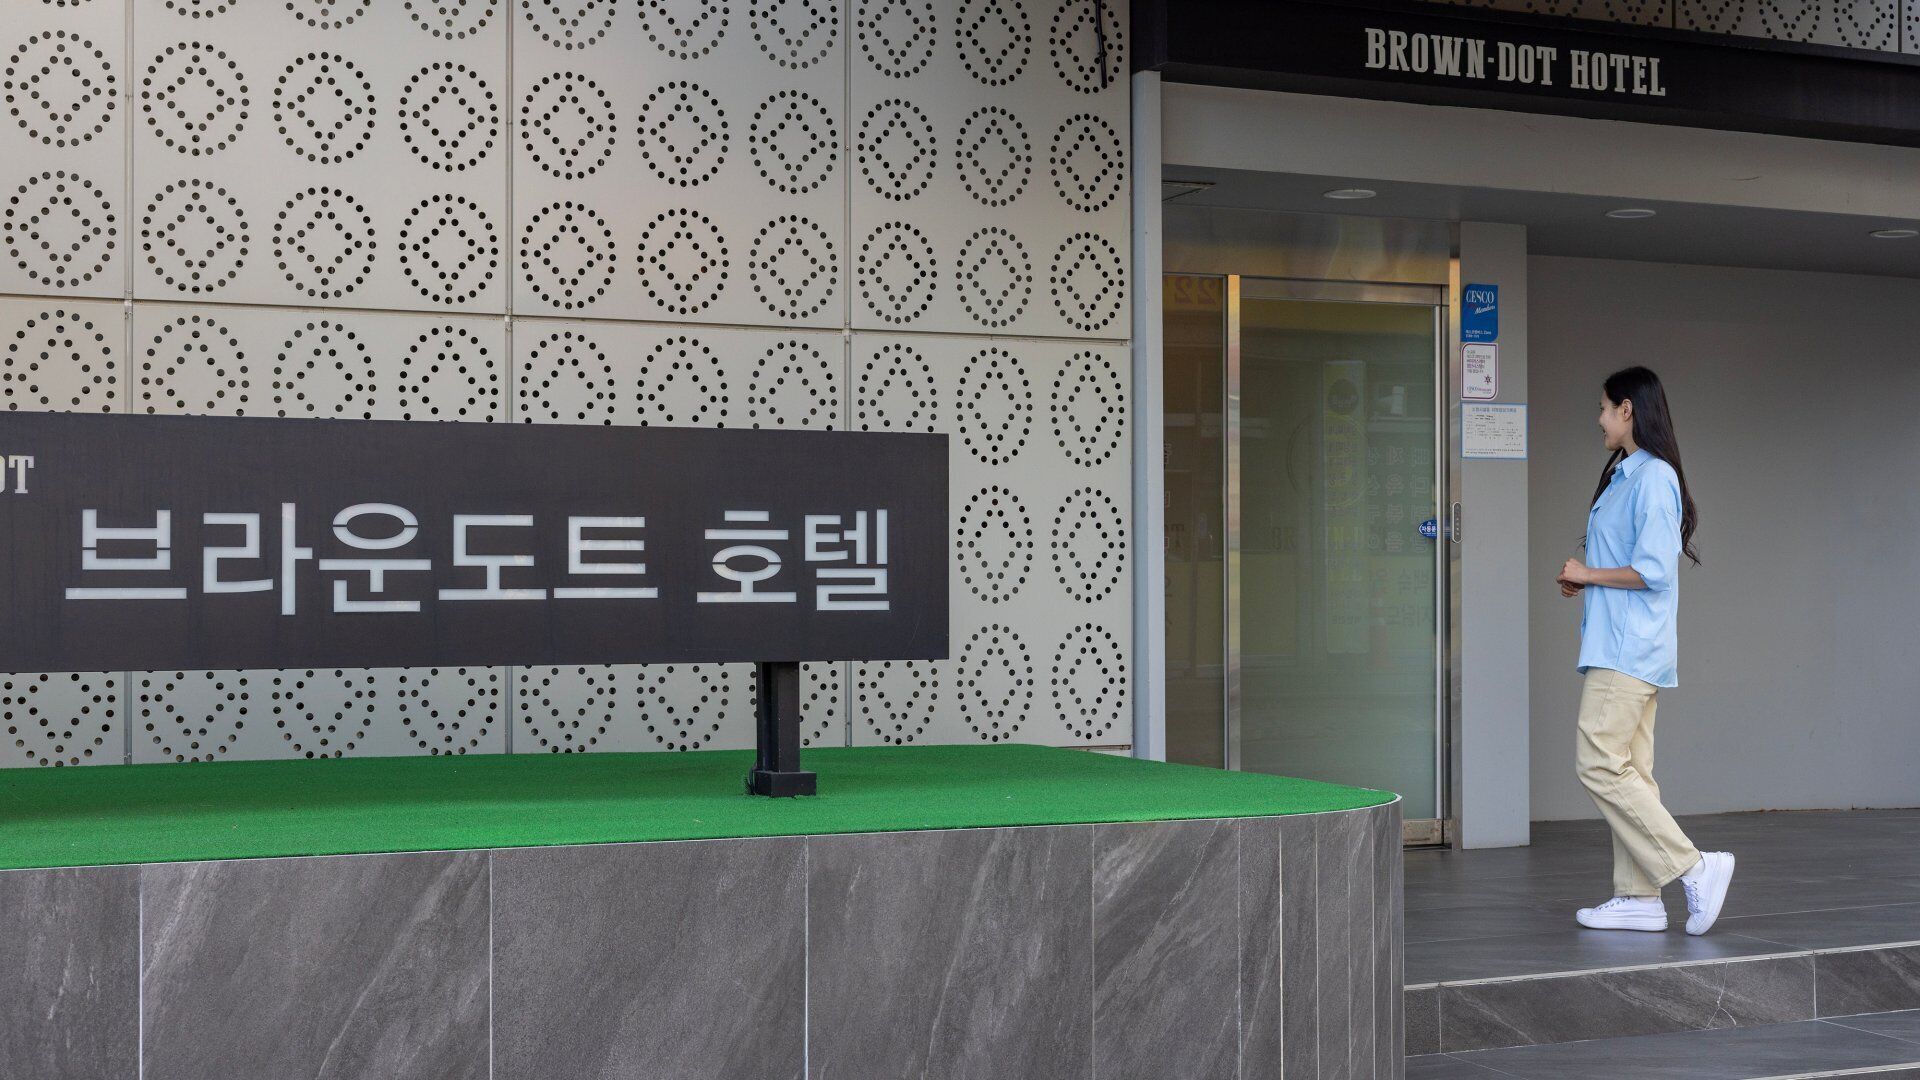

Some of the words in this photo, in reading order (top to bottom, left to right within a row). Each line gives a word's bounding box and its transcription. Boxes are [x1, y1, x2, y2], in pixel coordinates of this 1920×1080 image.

[1570, 49, 1666, 97] HOTEL
[1466, 290, 1495, 304] CESCO
[65, 502, 659, 617] 브라운도트
[696, 508, 891, 613] 호텔
